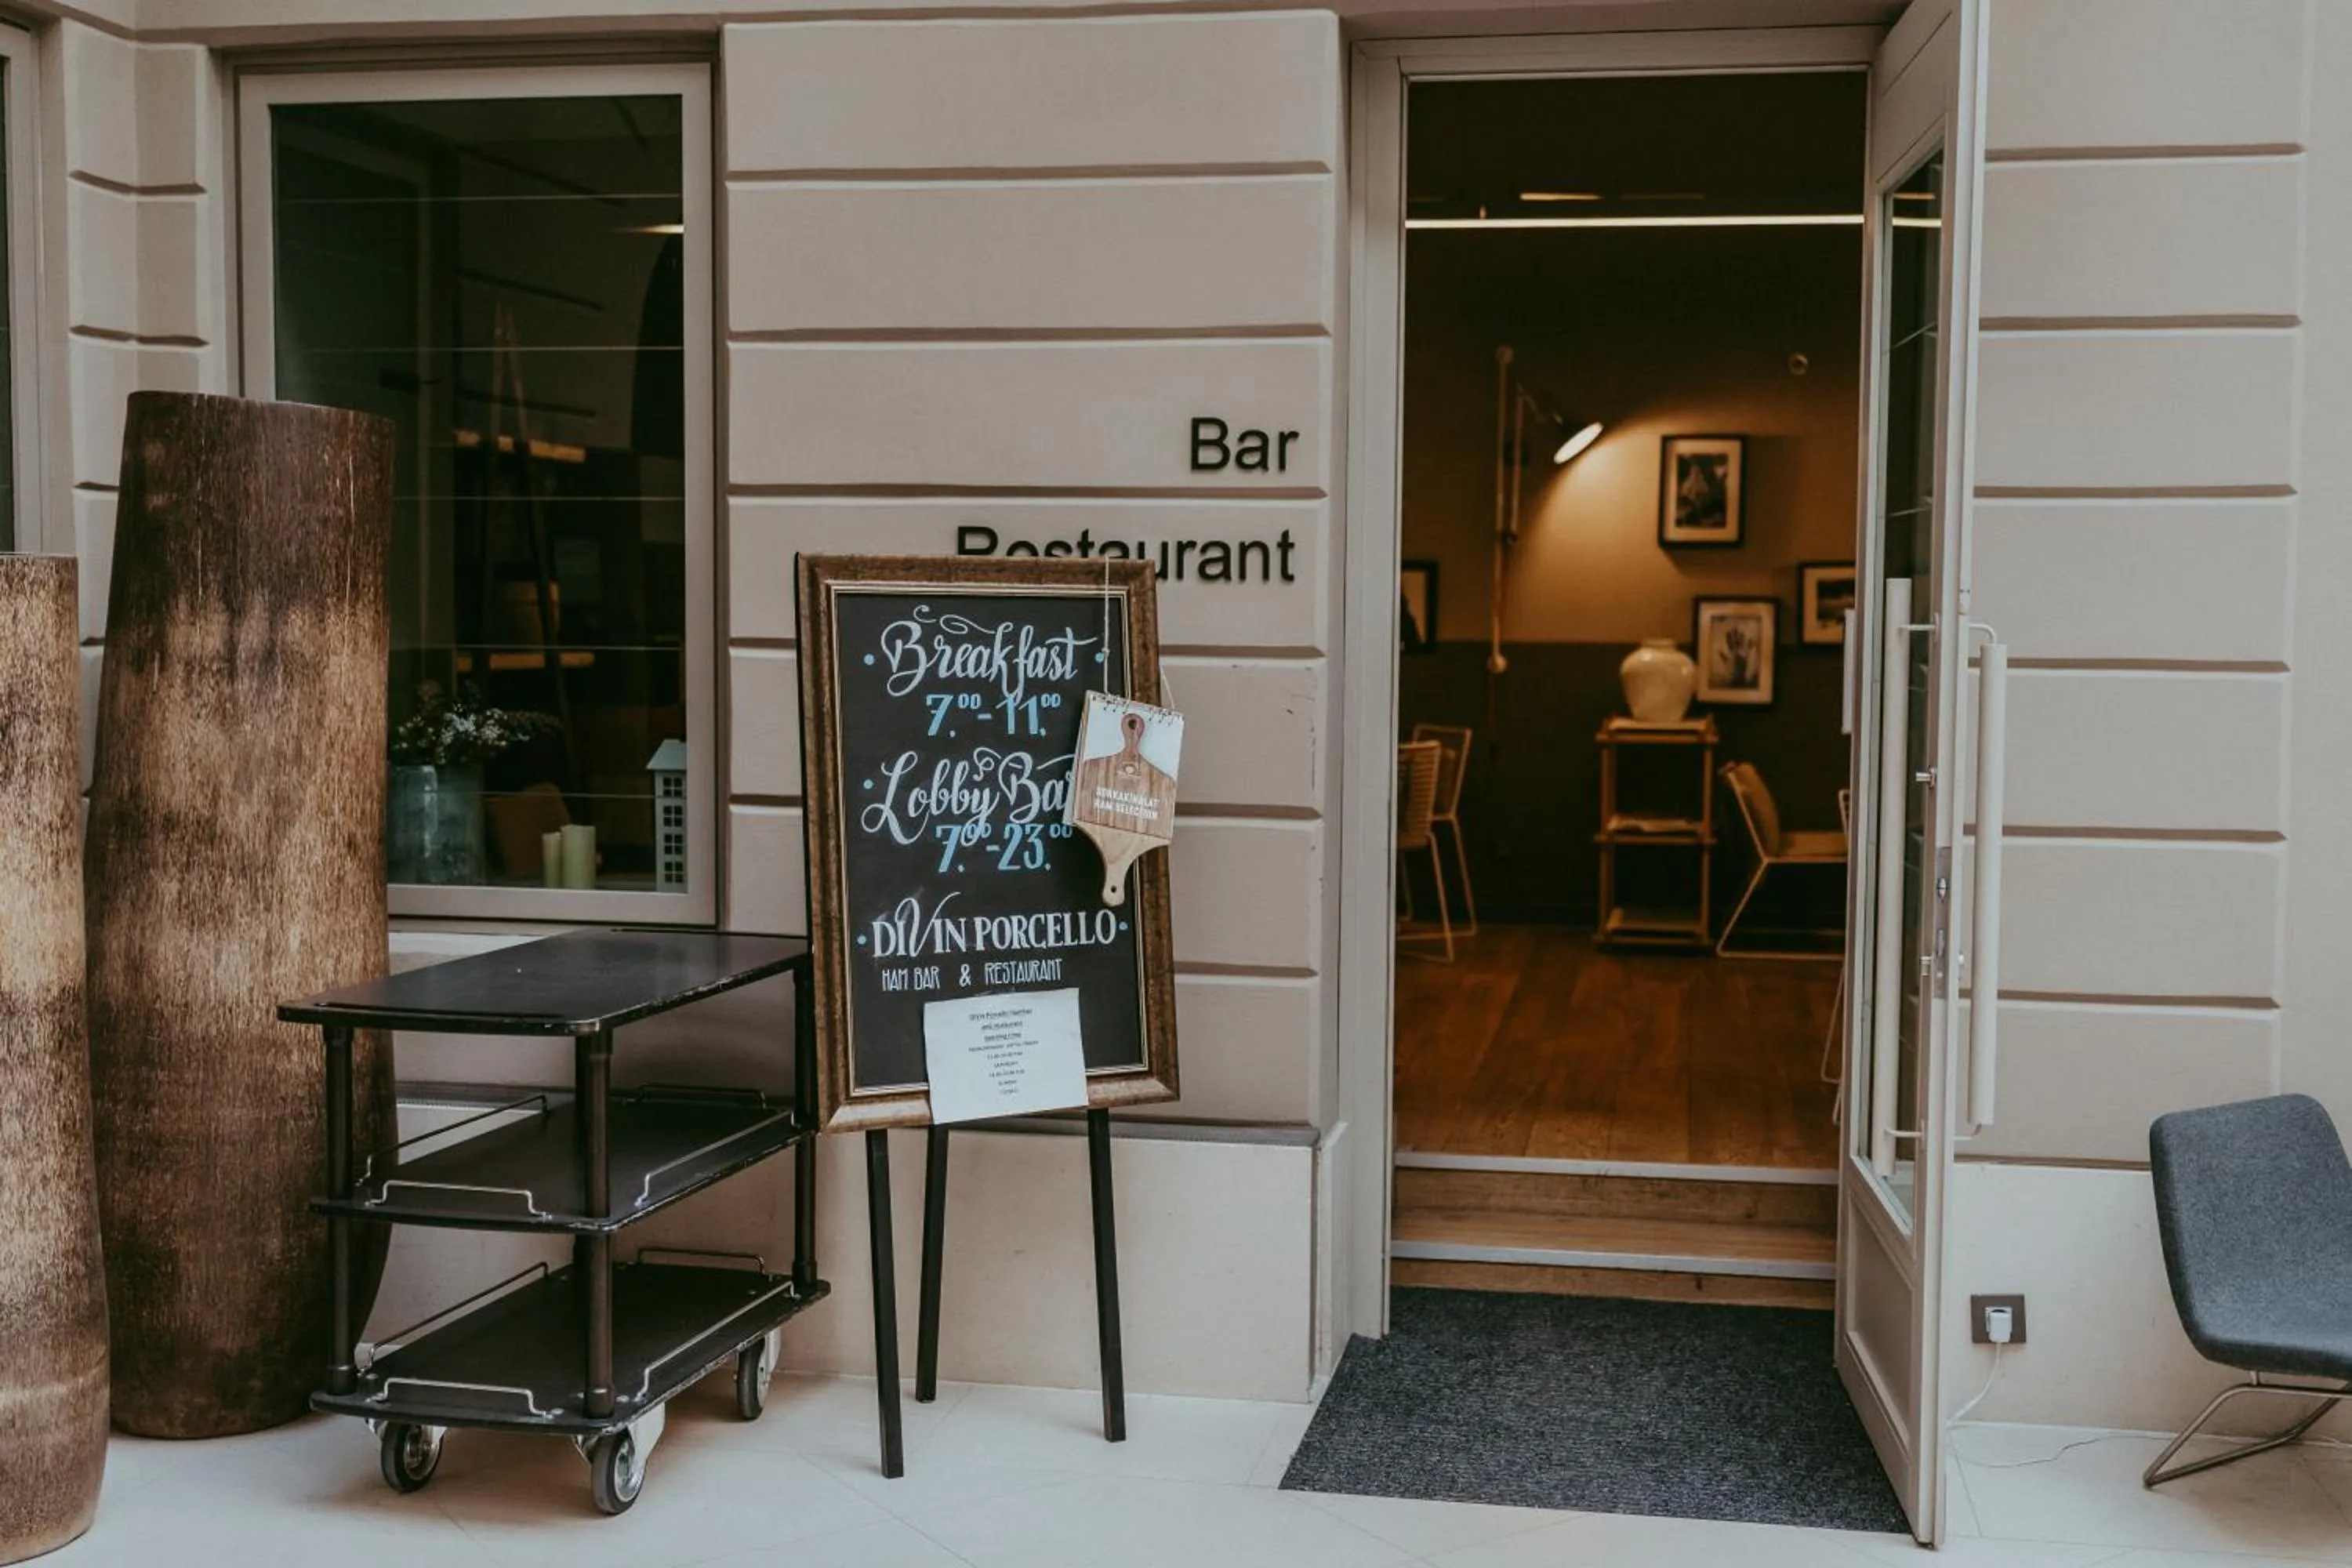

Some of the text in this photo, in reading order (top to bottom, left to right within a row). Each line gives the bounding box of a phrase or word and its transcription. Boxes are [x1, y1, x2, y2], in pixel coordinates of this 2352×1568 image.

[1190, 416, 1300, 472] Bar
[880, 605, 1098, 699] Breakfast
[862, 750, 1001, 846] Lobby
[973, 909, 1116, 951] PORCELLO
[882, 959, 1063, 991] HAM BAR & RESTAURANT
